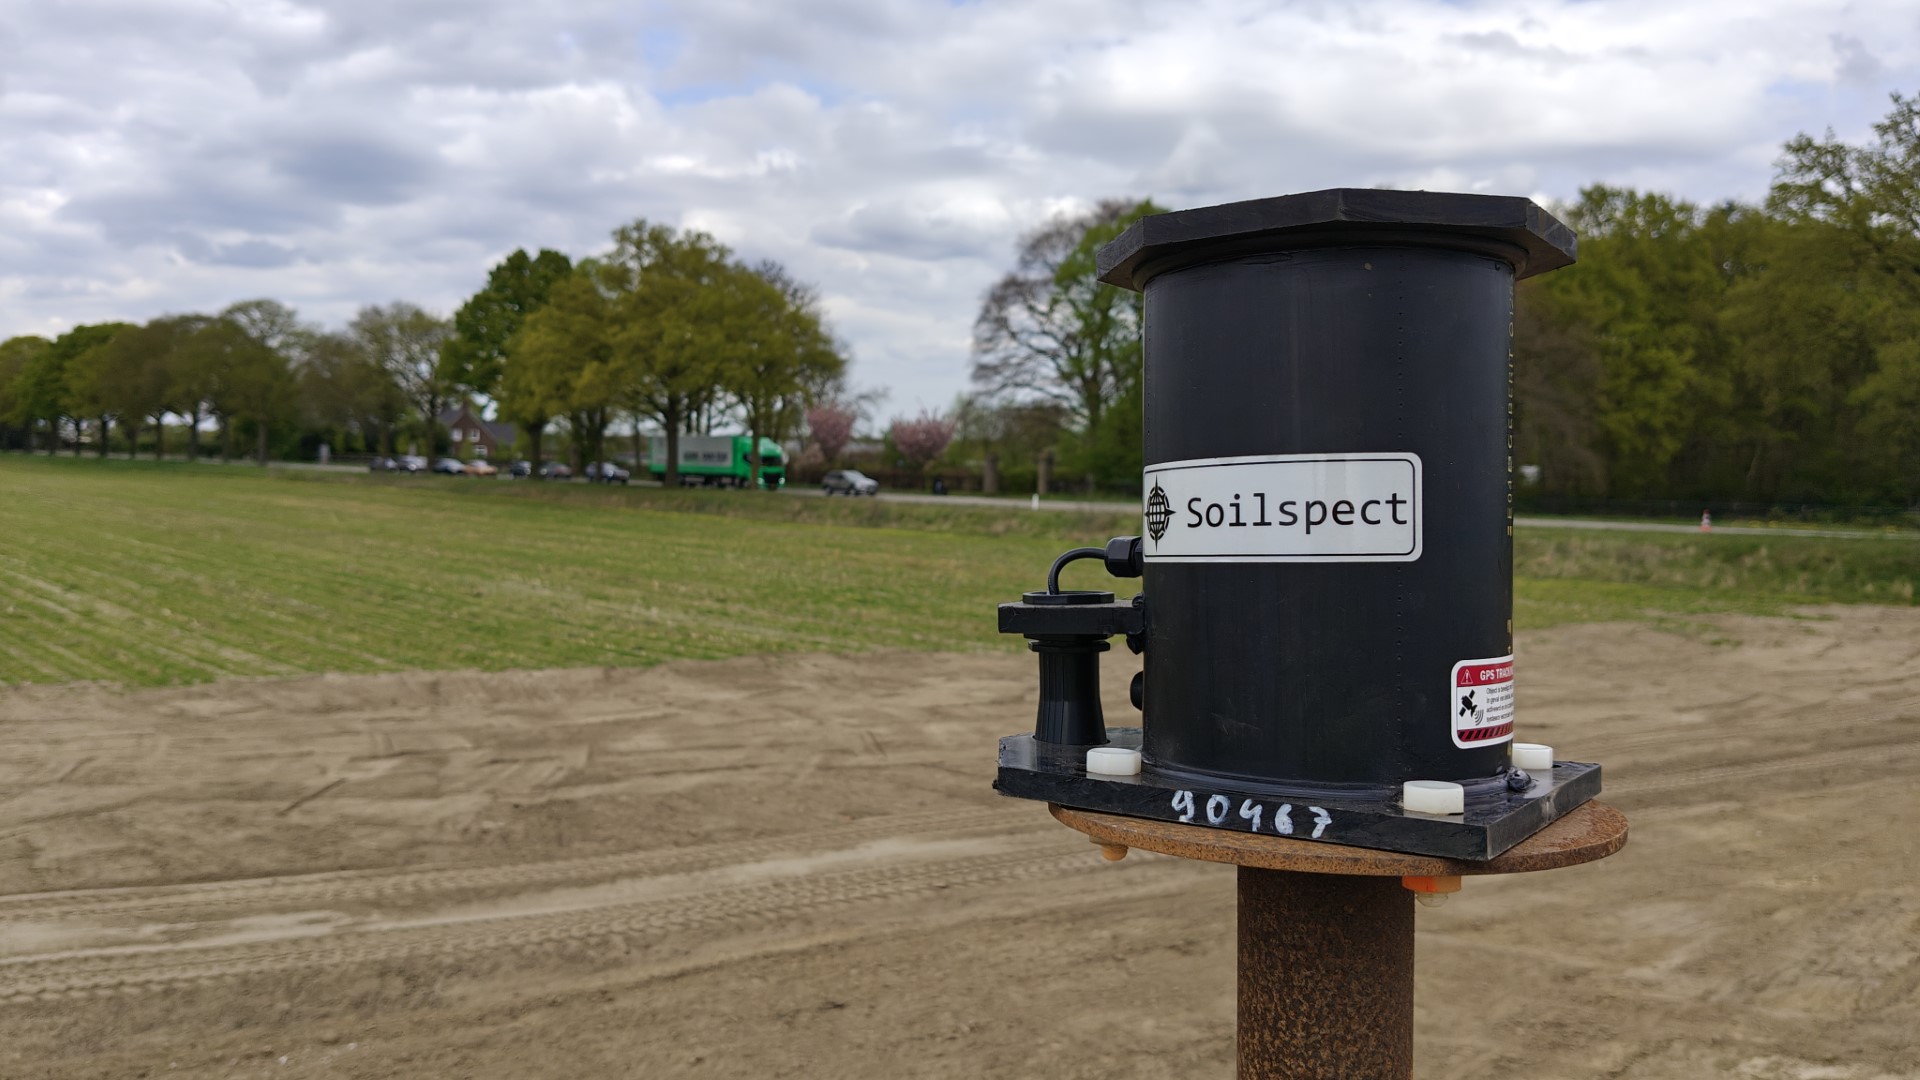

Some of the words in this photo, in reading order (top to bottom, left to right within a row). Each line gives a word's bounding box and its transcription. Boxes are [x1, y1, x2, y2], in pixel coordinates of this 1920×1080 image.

[1187, 492, 1407, 534] Soilspect
[1480, 670, 1494, 680] GPS
[1171, 790, 1332, 839] 90467
